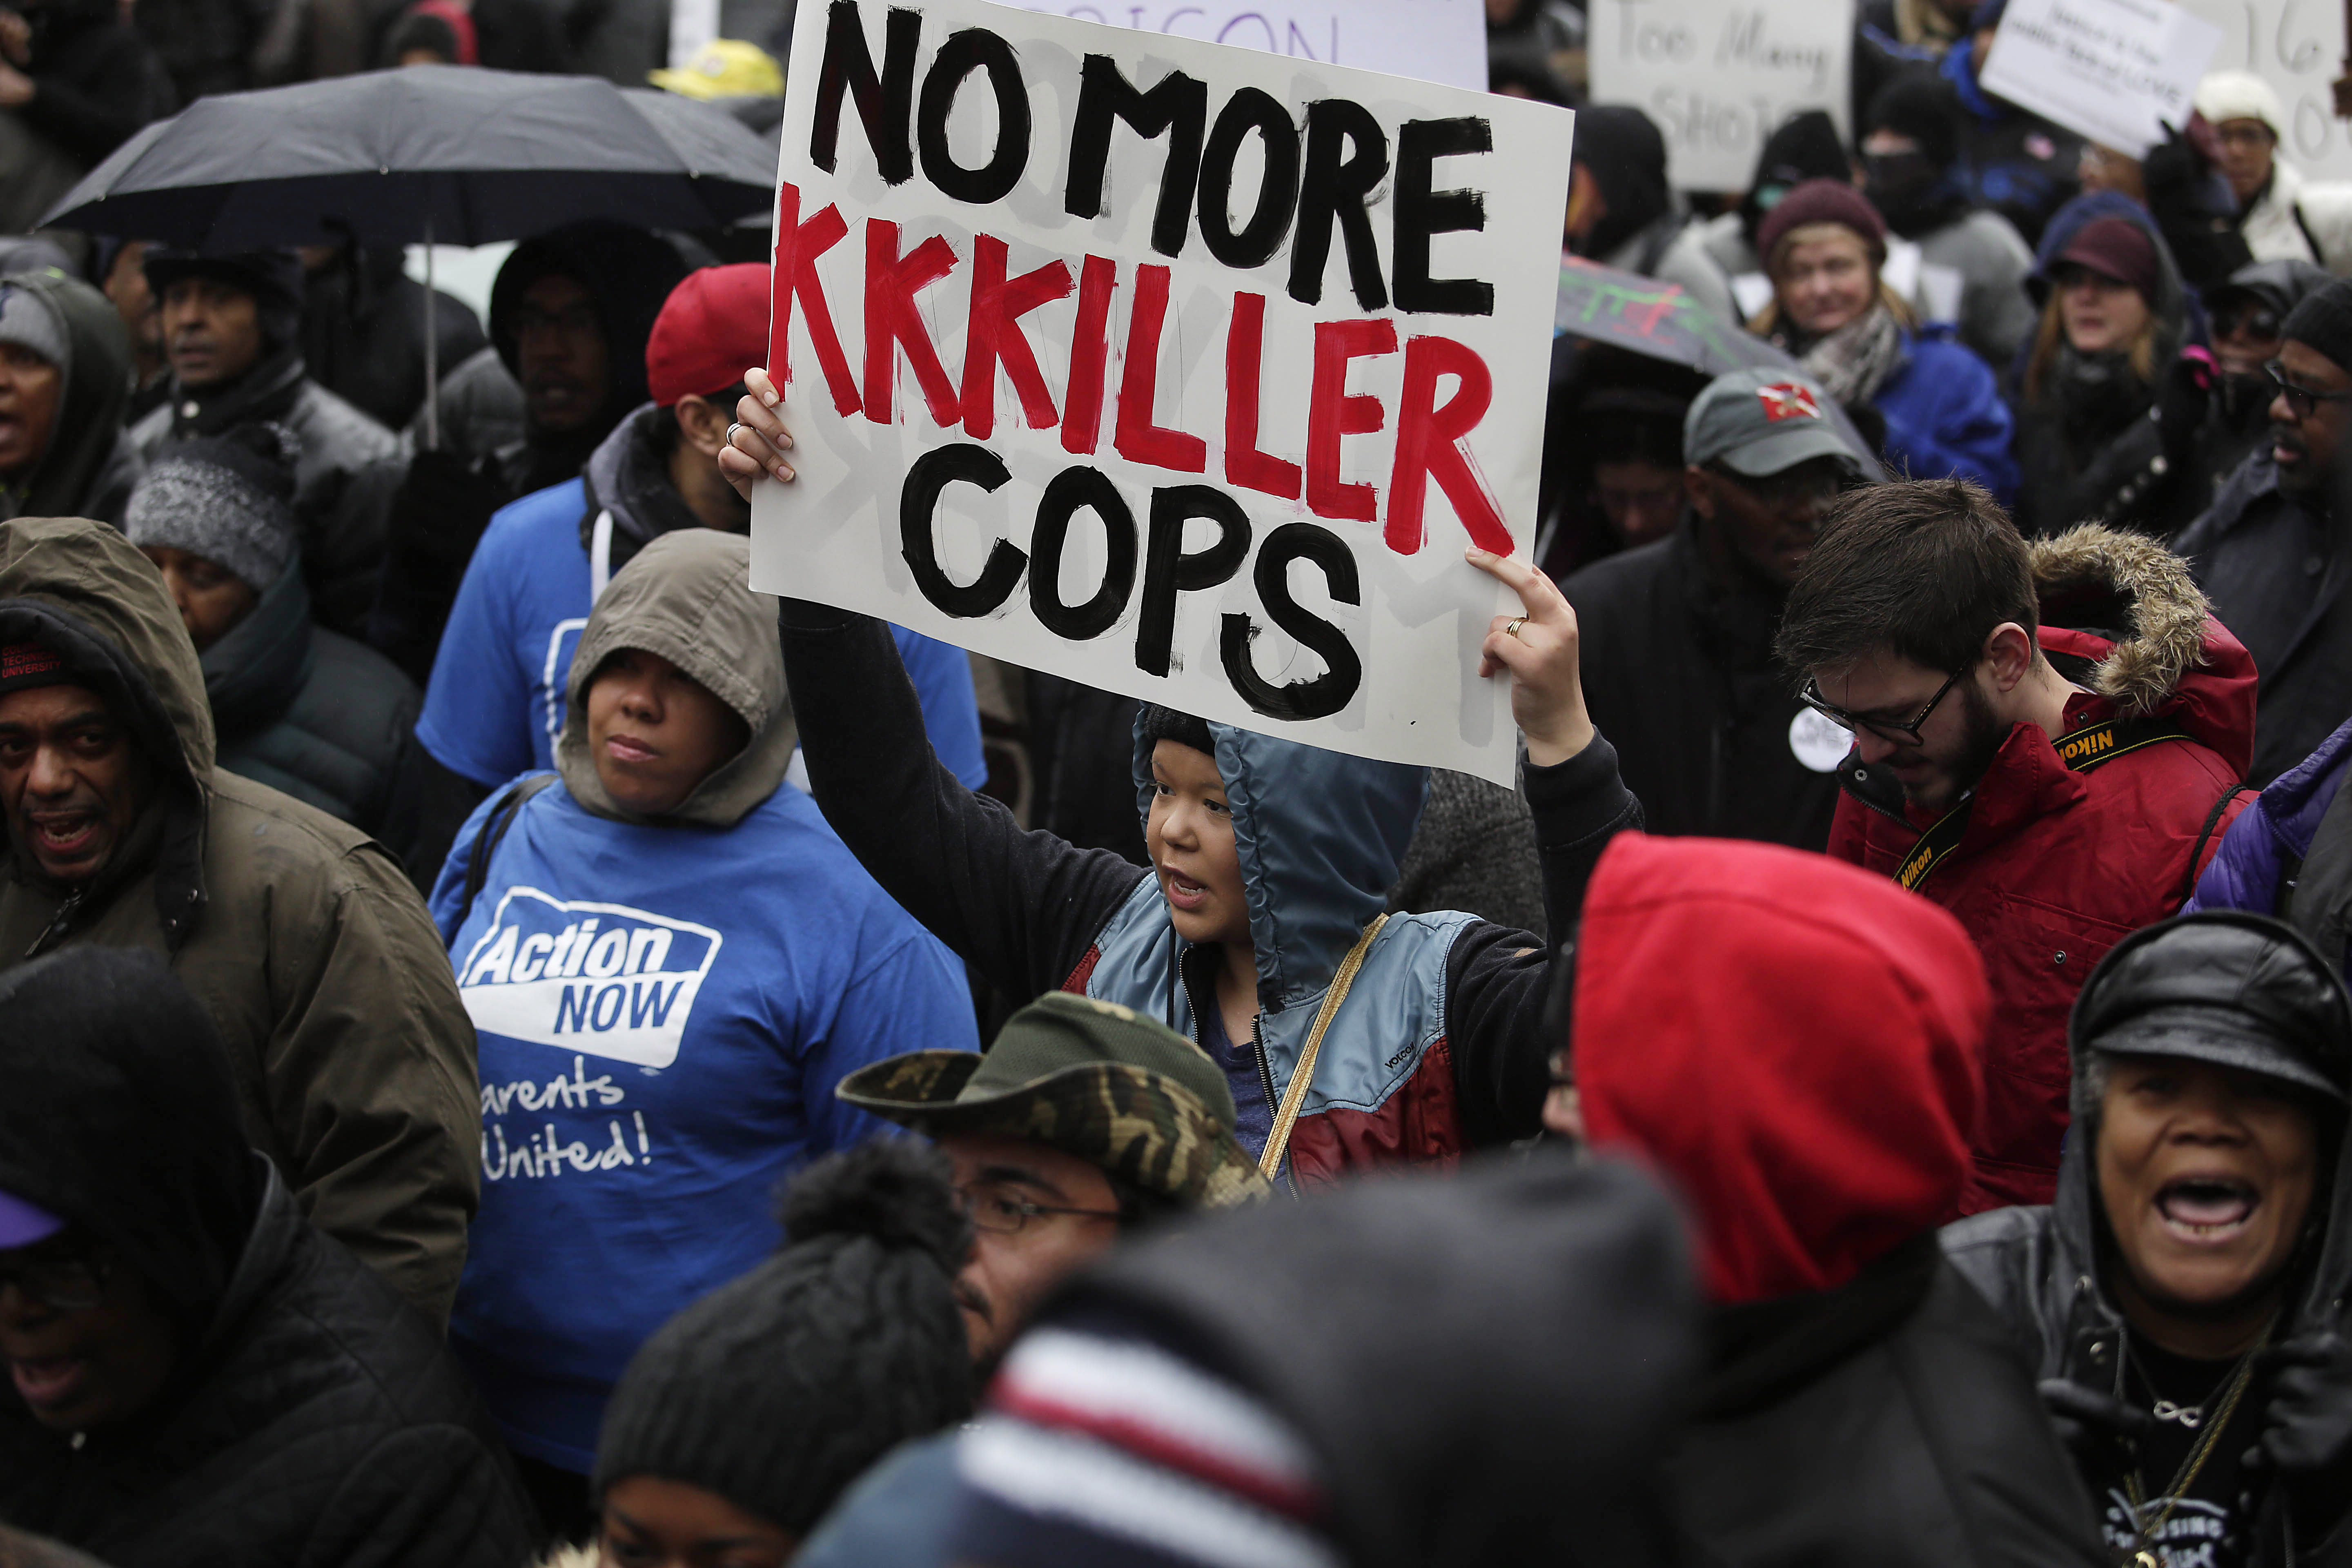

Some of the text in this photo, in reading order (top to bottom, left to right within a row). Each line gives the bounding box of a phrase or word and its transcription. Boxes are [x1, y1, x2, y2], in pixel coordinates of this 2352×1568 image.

[810, 0, 1494, 316] NO MORE
[767, 182, 1515, 558] KKKILLER
[900, 443, 1362, 721] COPS
[2, 659, 62, 678] UNIVERSITY
[1901, 847, 1932, 892] Nikon
[466, 918, 673, 986] Action
[554, 981, 684, 1034] NOW
[481, 1055, 625, 1114] arents
[481, 1110, 652, 1181] United!
